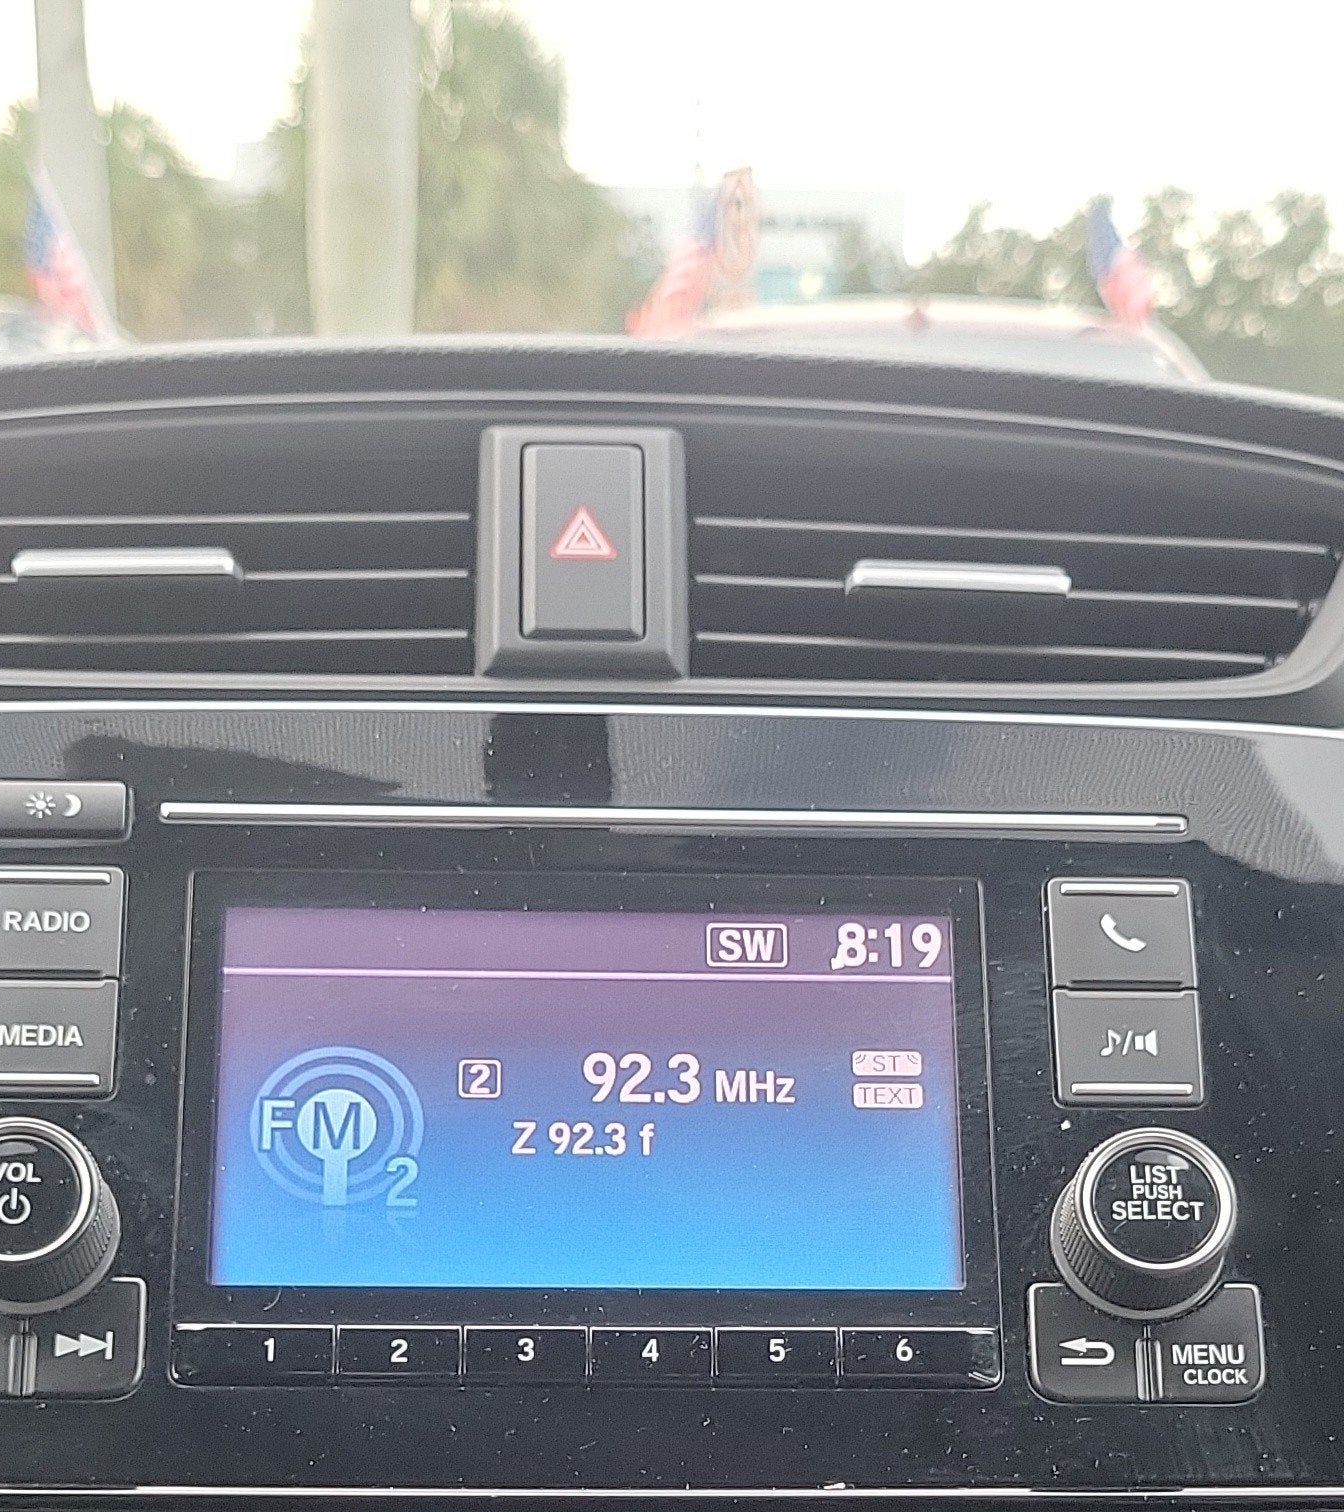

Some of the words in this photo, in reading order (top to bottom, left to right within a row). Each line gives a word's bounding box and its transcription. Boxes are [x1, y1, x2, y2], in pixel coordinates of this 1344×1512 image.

[3, 911, 90, 933] RADIO
[718, 931, 777, 962] SW
[838, 924, 942, 968] 8:19
[872, 1054, 901, 1073] ST
[583, 1053, 702, 1104] 92.3
[715, 1070, 796, 1104] MHz
[858, 1086, 918, 1105] TEXT
[511, 1122, 536, 1154] Z
[548, 1121, 626, 1155] 92.3
[639, 1123, 655, 1155] f
[385, 1158, 419, 1206] 2
[1129, 1165, 1180, 1185] LIST
[1132, 1184, 1182, 1200] PUSH
[1112, 1201, 1204, 1222] SELECT
[263, 1339, 276, 1361] 1
[390, 1339, 409, 1363] 2
[516, 1338, 535, 1361] 3
[641, 1338, 659, 1363] 4
[768, 1338, 786, 1363] 5
[895, 1338, 914, 1362] 6
[1171, 1343, 1245, 1366] MENU
[1183, 1368, 1248, 1385] CLOCK
